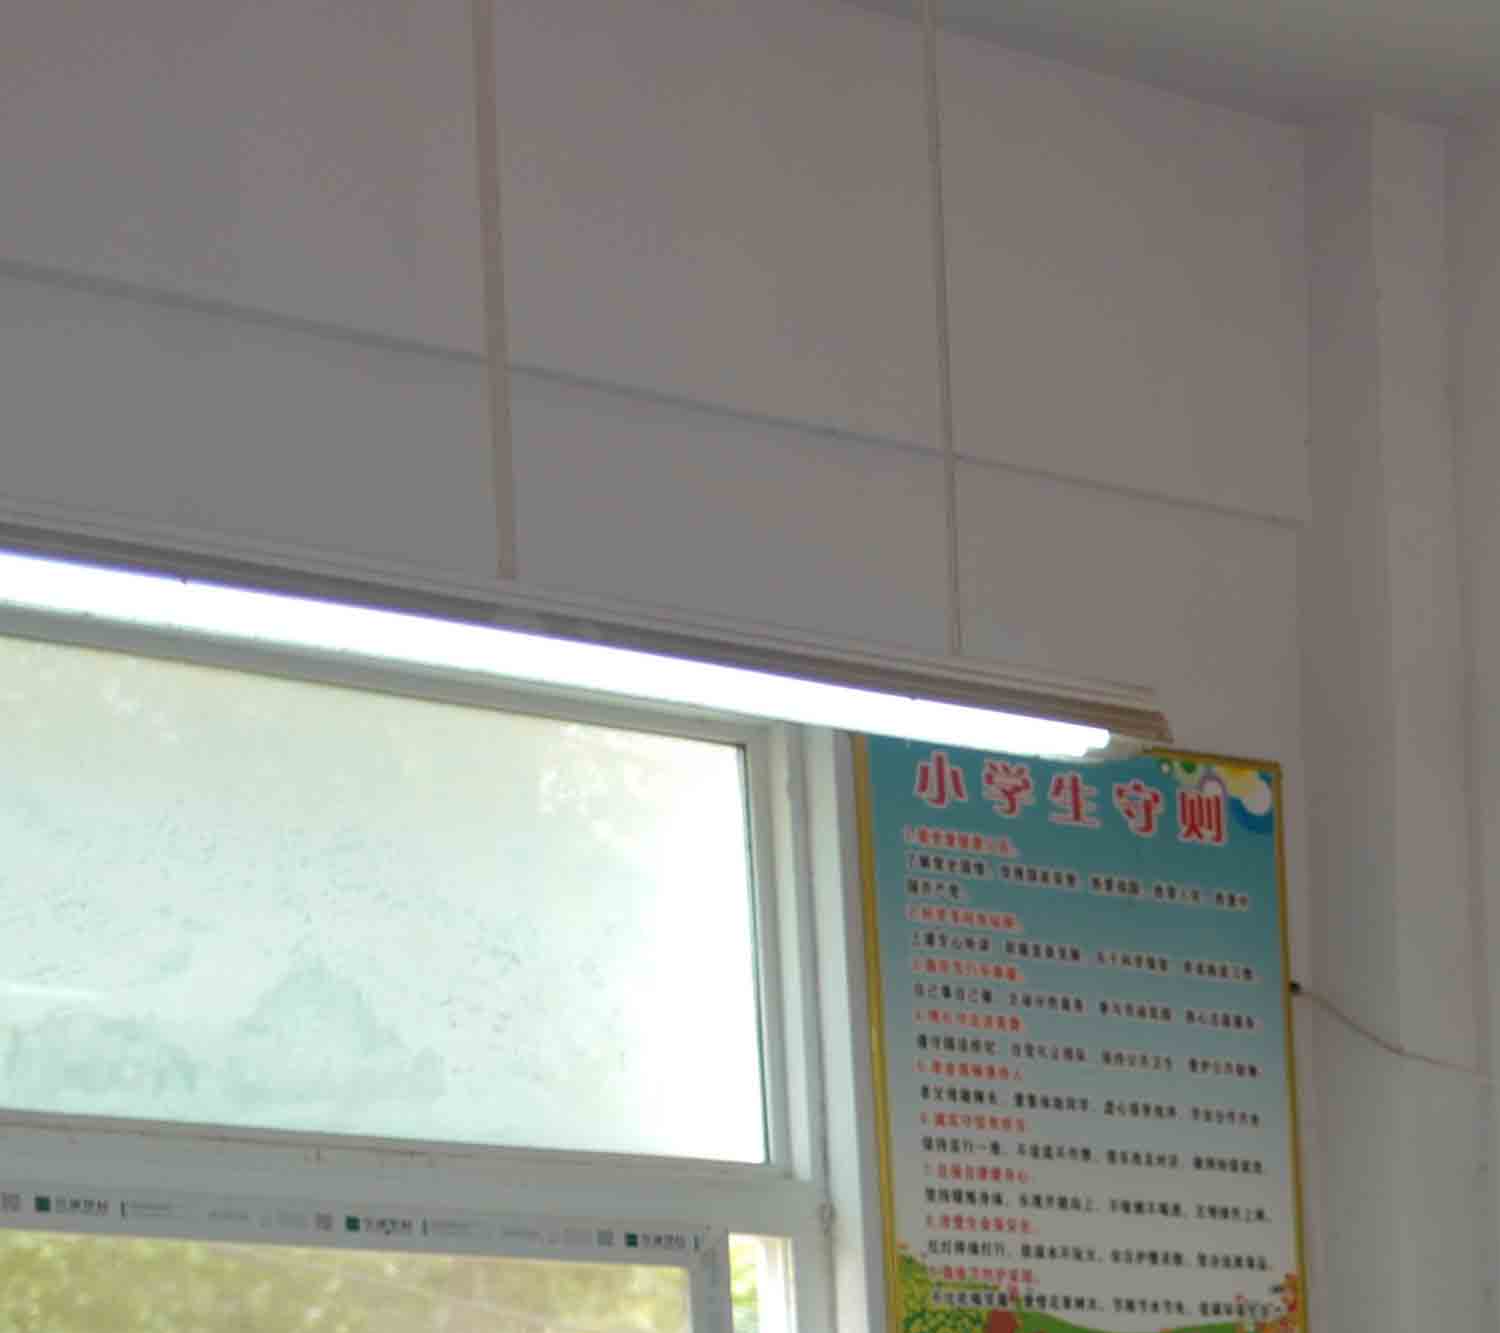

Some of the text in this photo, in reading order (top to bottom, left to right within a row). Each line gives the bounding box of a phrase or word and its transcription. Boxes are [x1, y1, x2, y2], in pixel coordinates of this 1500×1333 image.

[914, 751, 1228, 845] 小学生守则
